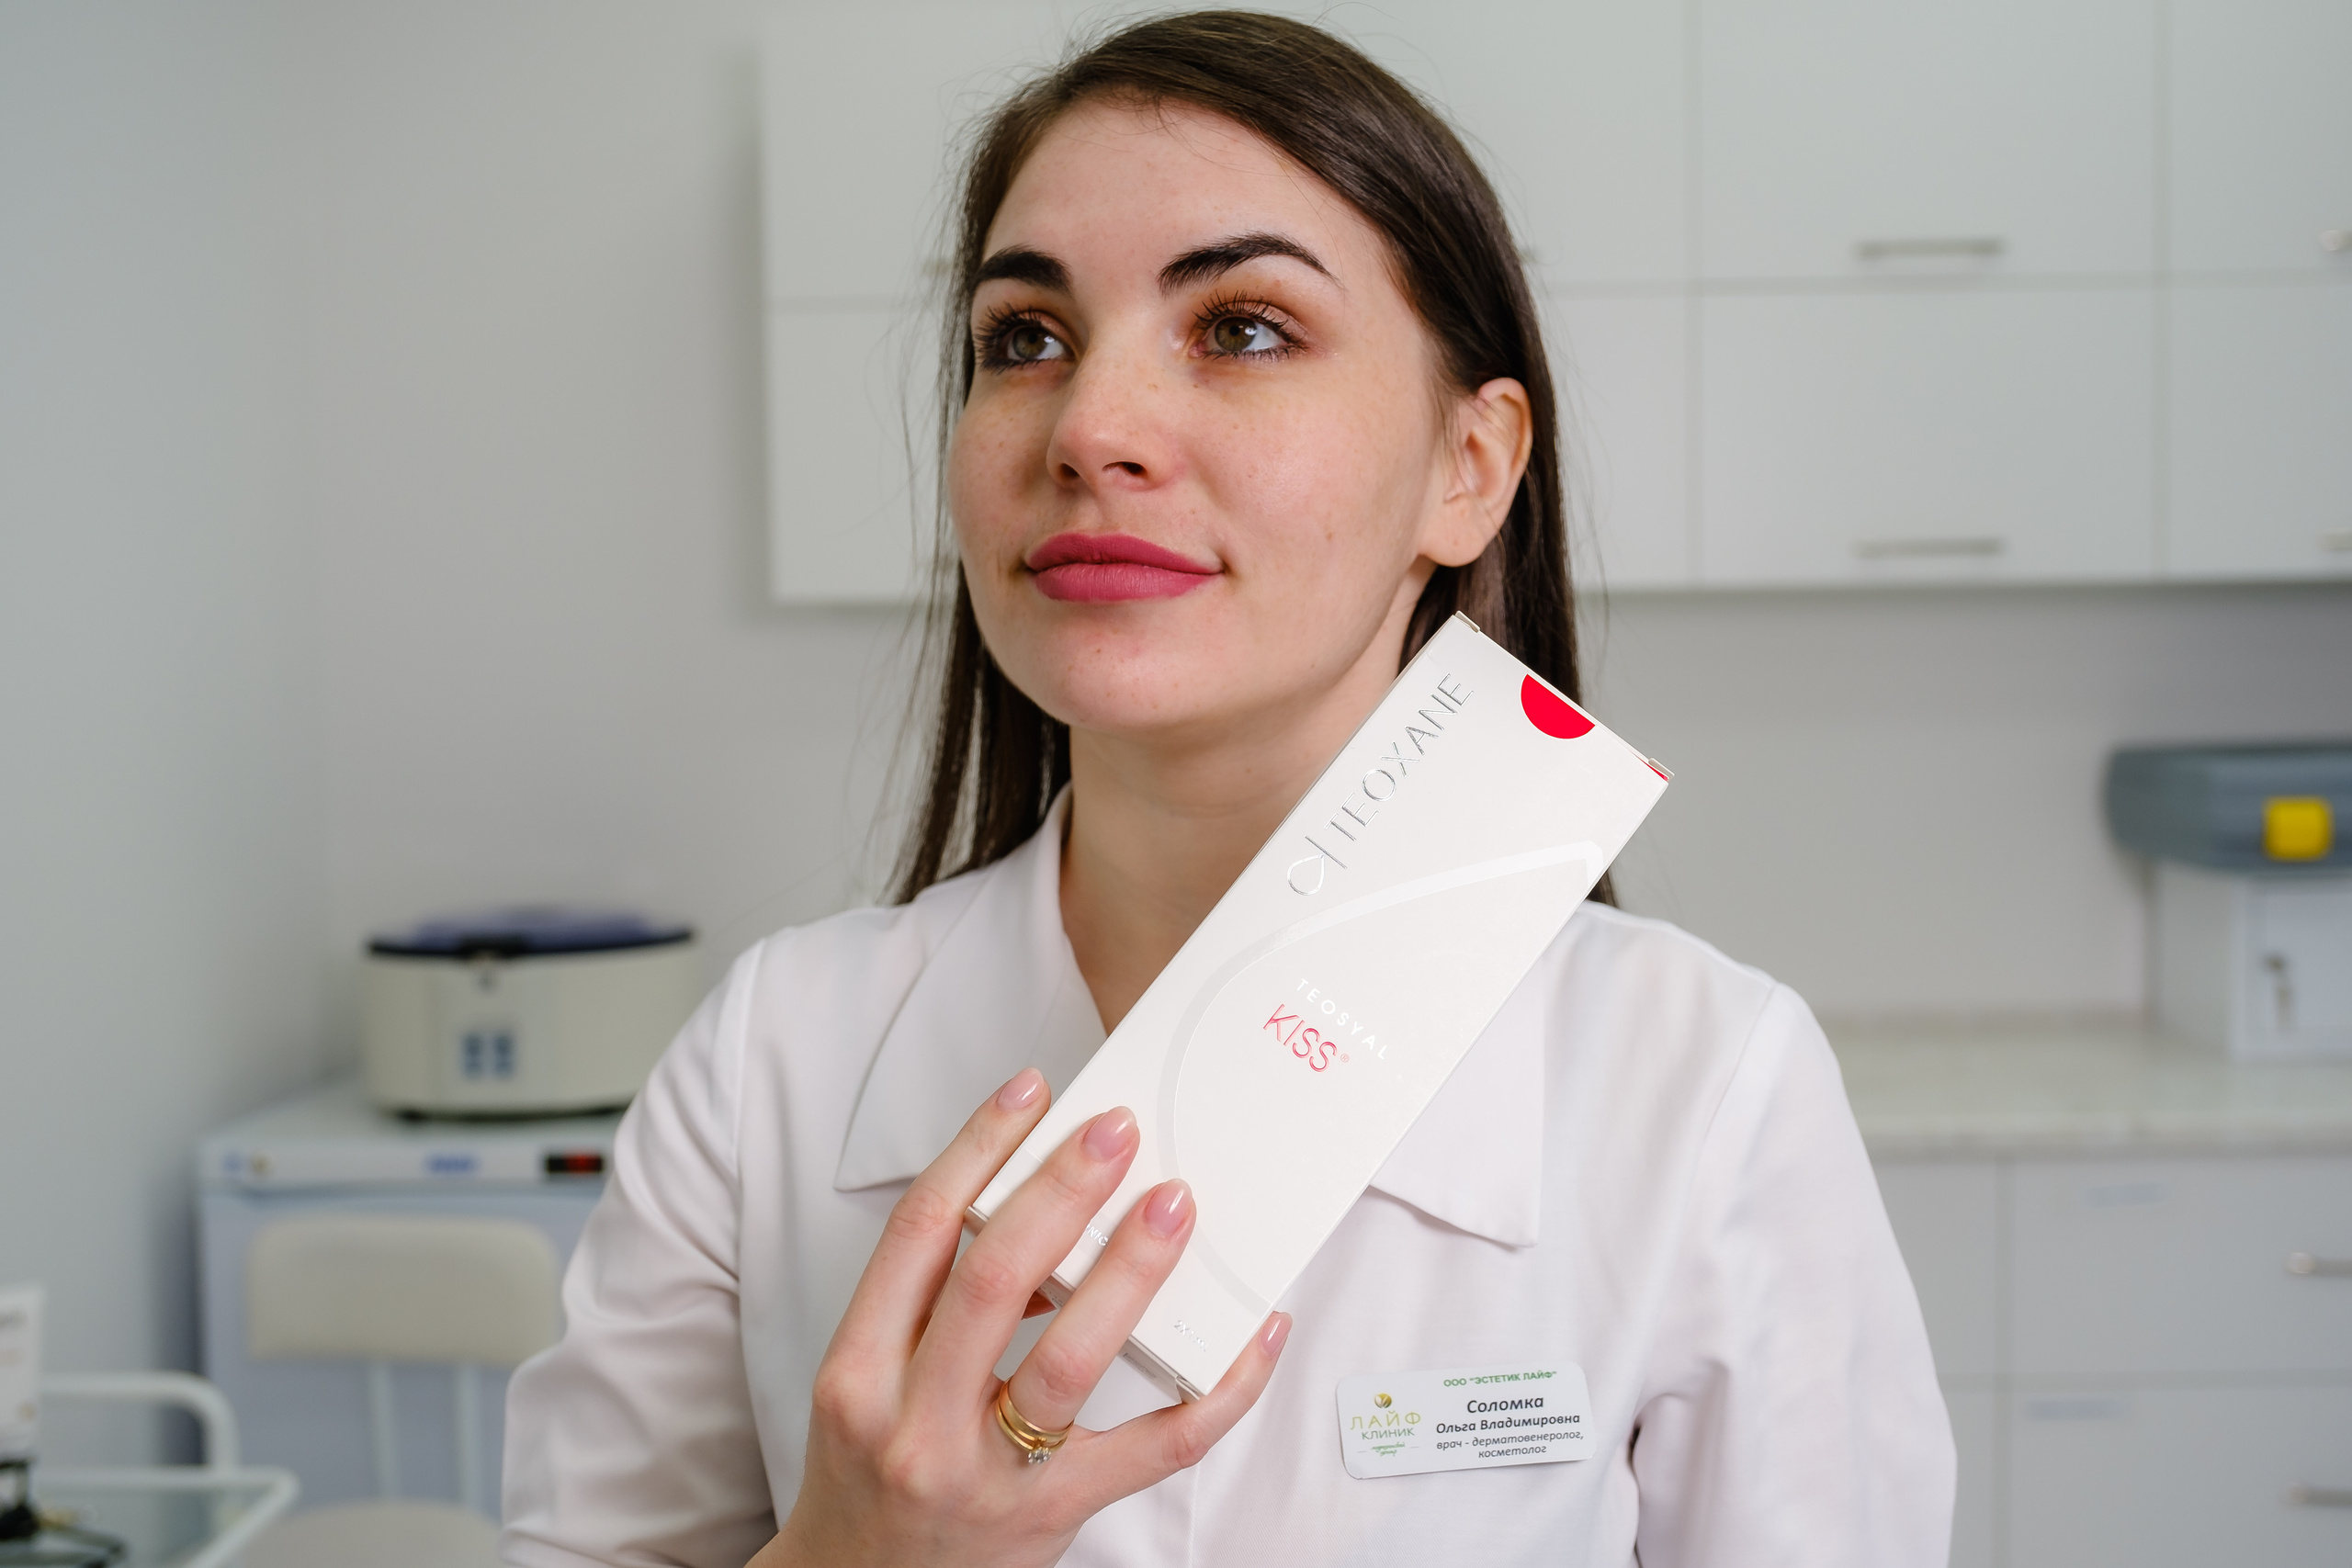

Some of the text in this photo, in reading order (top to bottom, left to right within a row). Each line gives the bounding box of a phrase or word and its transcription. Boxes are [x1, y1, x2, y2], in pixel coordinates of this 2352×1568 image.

[1323, 672, 1475, 842] TEOXANE
[1295, 977, 1388, 1061] TEOSYAL
[1443, 1377, 1467, 1387] ООО
[1466, 1396, 1544, 1414] Соломка
[1350, 1410, 1422, 1431] ЛАЙФ
[1436, 1414, 1580, 1435] Ольга Владимировна
[1362, 1427, 1416, 1441] КЛИНИК
[1436, 1439, 1463, 1451] врач
[1472, 1430, 1584, 1448] дерматовенеролог,
[1478, 1445, 1547, 1459] косметолог
